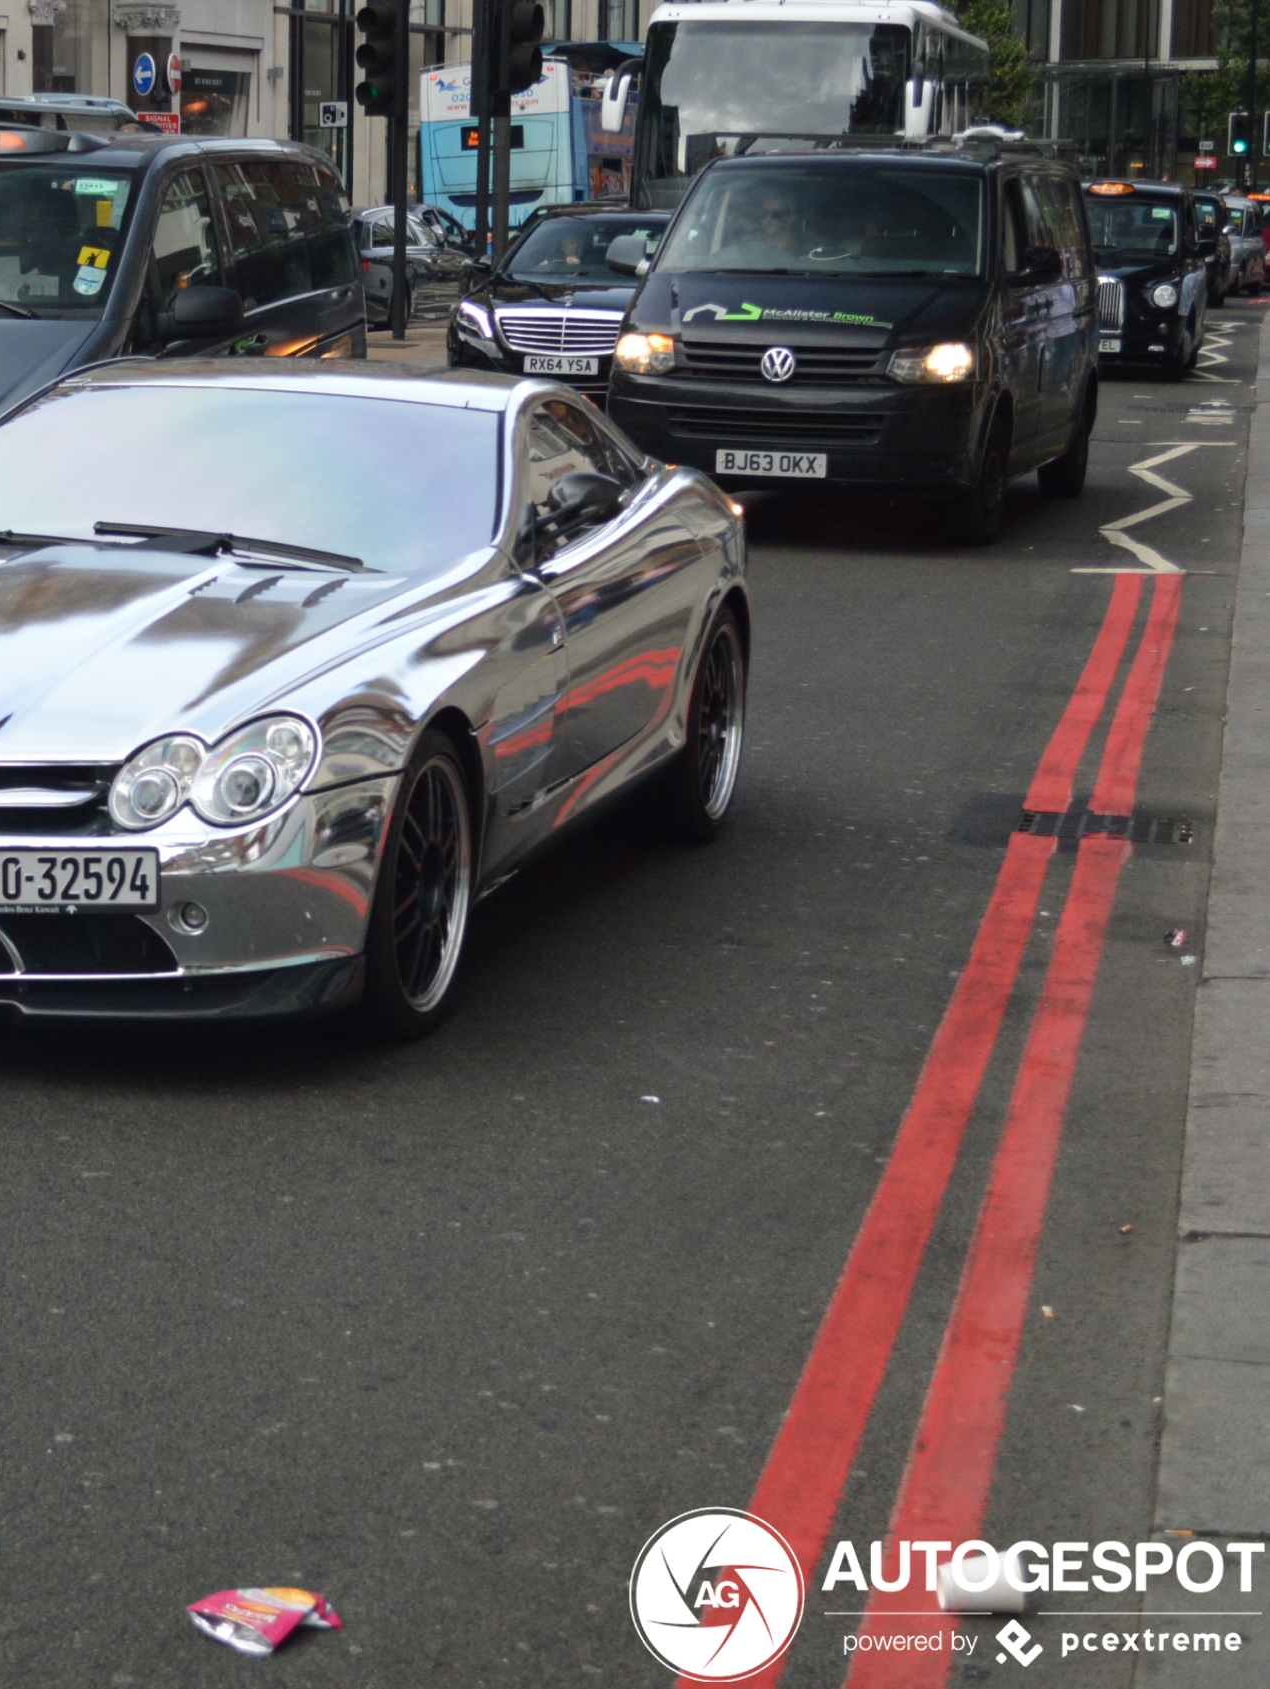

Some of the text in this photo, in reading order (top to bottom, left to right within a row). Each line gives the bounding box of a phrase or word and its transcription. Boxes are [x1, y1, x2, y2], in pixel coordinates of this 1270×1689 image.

[145, 115, 172, 123] SIGNAL
[762, 309, 875, 322] McAlister Brown
[530, 358, 592, 371] RX64 YSA
[724, 452, 818, 474] BJ63 OKX
[35, 905, 60, 914] Kuwait
